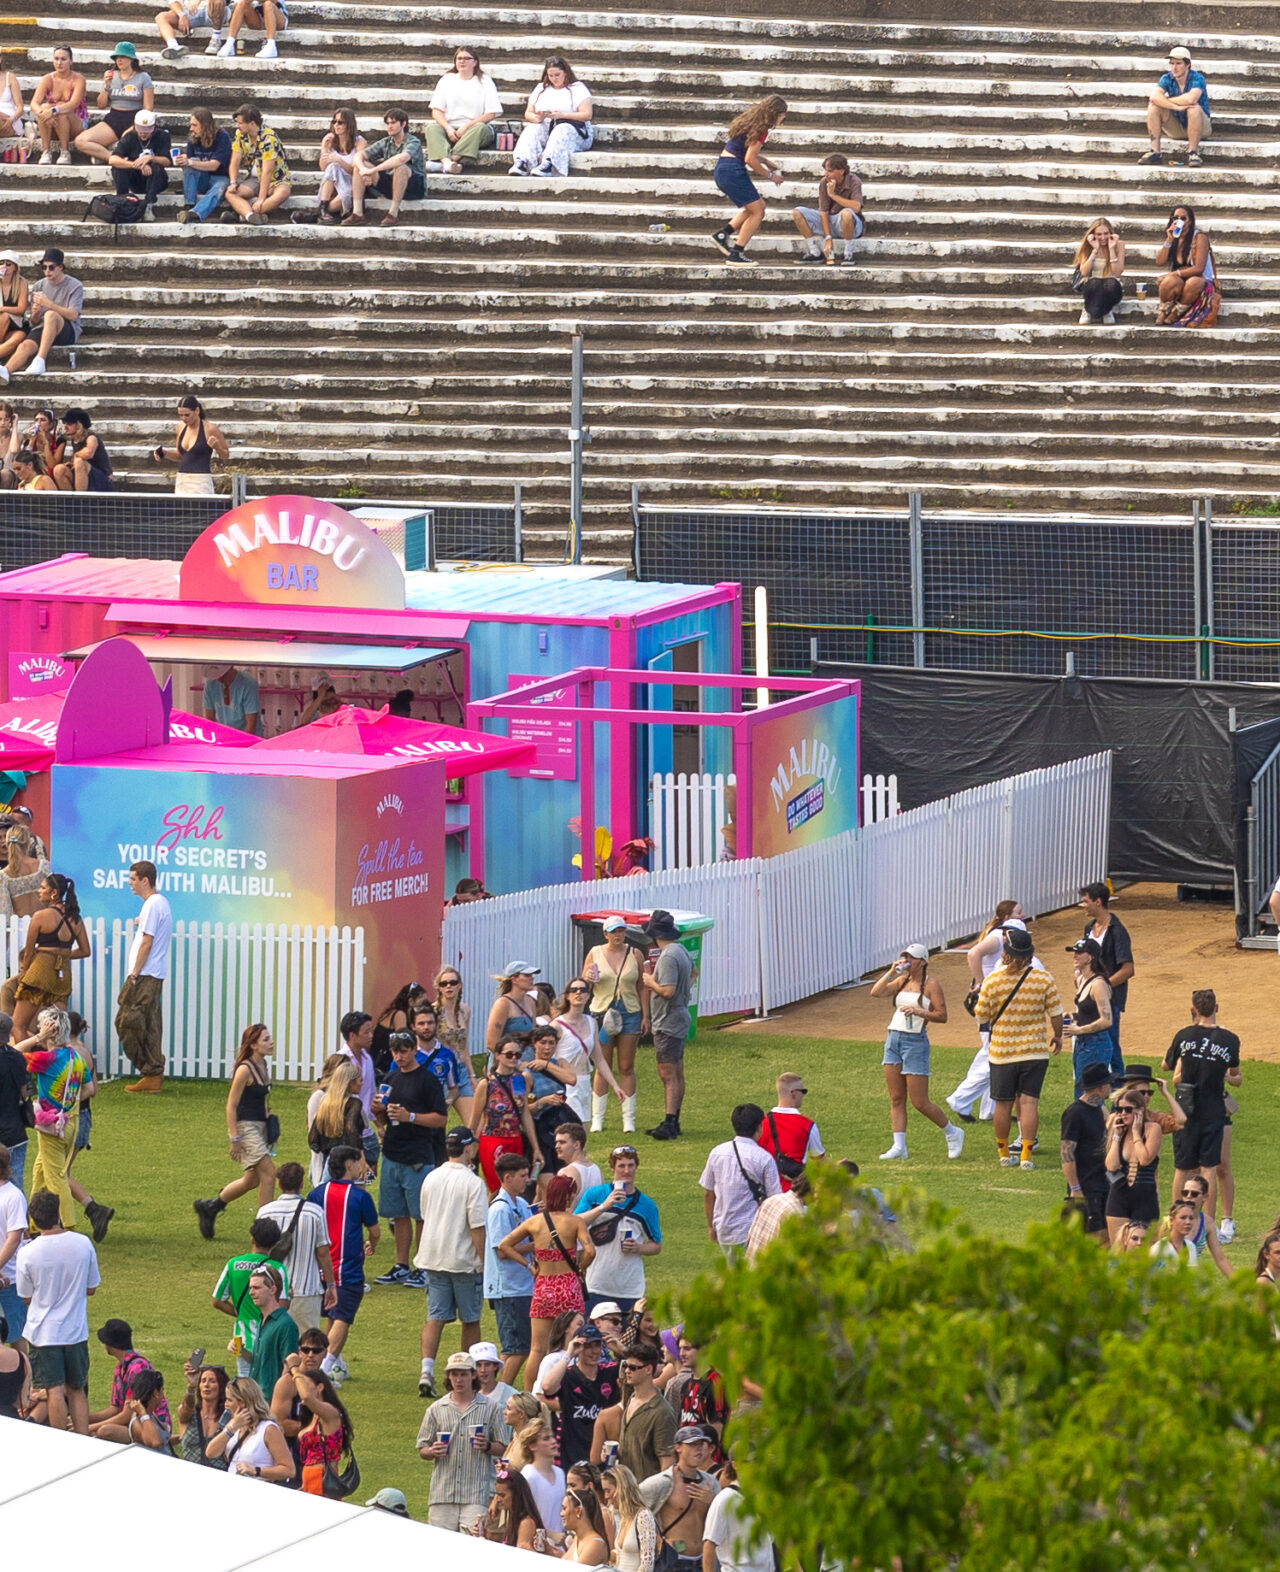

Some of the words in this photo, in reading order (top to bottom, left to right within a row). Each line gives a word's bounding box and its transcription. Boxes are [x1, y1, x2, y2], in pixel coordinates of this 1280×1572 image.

[212, 511, 368, 571] MALIBU
[267, 563, 319, 591] BAR
[18, 657, 66, 677] MALIBU
[384, 741, 484, 757] ALIBU
[770, 739, 841, 813] MALIBU
[376, 794, 404, 818] MALIBU
[788, 802, 795, 818] DO
[795, 782, 823, 810] WHATEVER
[788, 807, 808, 830] TASTES
[809, 796, 823, 815] GOOD
[156, 804, 225, 853] Shh
[117, 844, 168, 865] YOUR
[354, 839, 388, 888] Spill
[387, 837, 405, 872] the
[407, 840, 423, 868] tea
[93, 868, 130, 889] SAF
[351, 885, 369, 907] FOR
[370, 880, 392, 903] FREE
[395, 873, 428, 898] MERCH!
[1180, 1040, 1196, 1056] Los
[573, 1404, 603, 1419] Zuli
